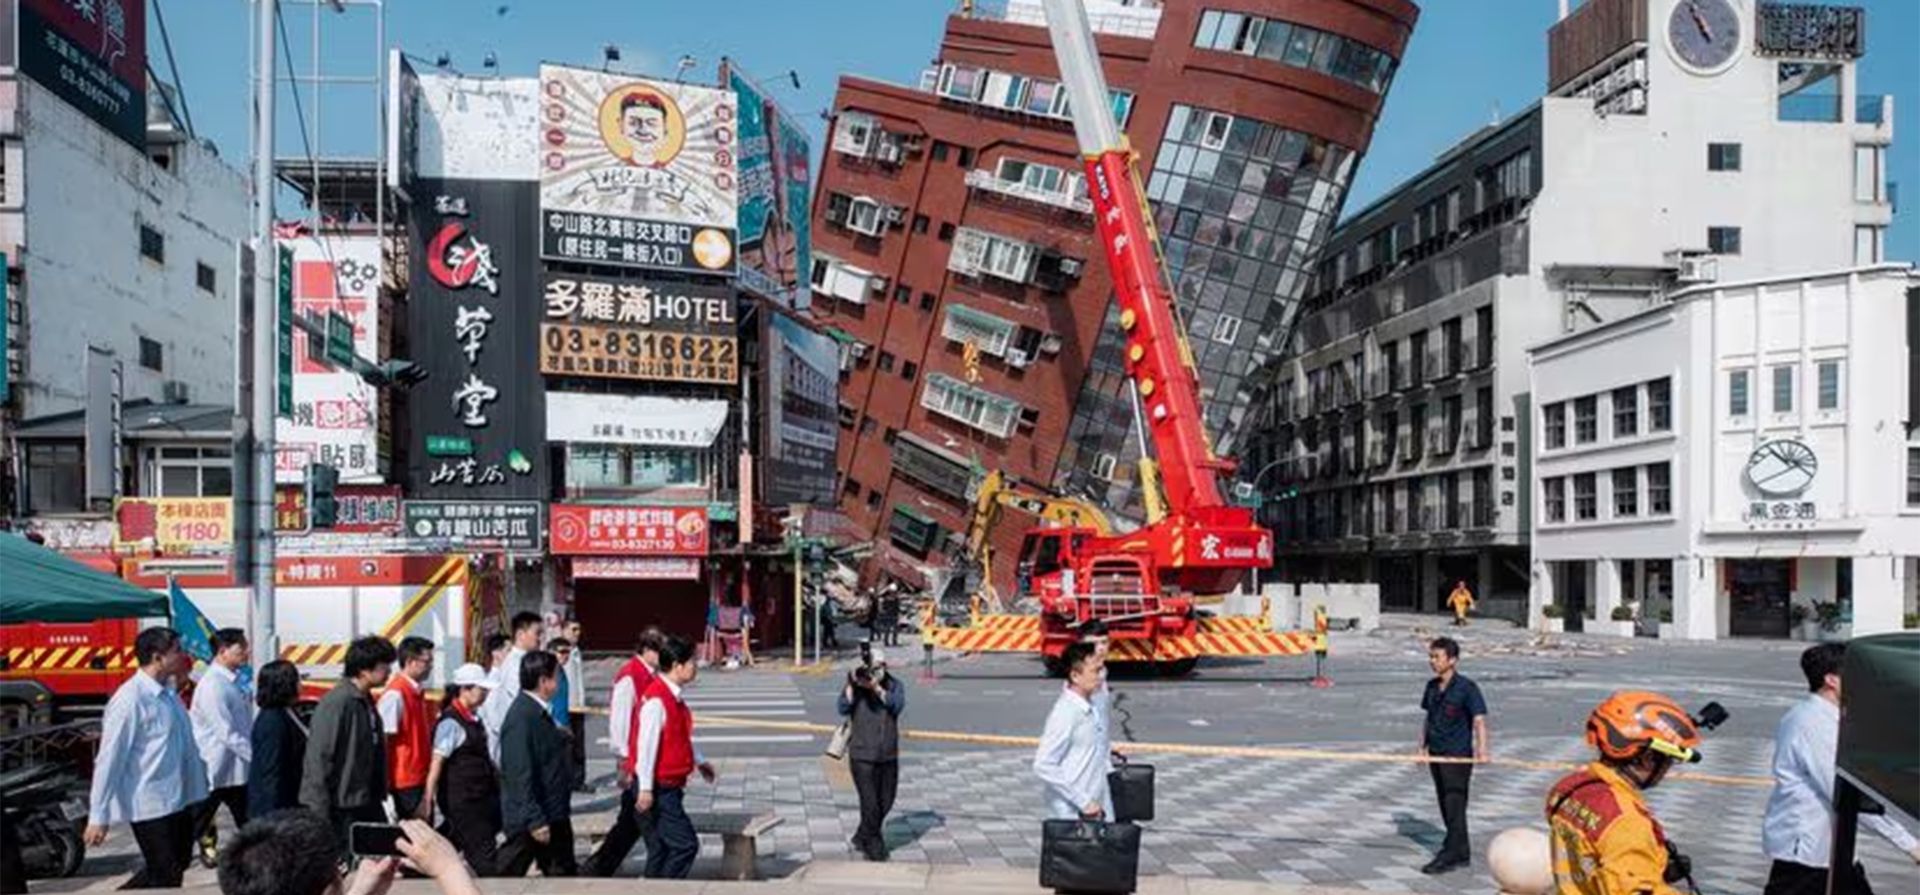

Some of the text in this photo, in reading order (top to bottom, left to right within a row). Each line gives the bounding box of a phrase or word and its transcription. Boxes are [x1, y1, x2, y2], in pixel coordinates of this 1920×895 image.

[544, 279, 735, 324] 多羅滿 HOTEL
[546, 325, 734, 364] 03-8316622
[170, 521, 221, 541] 1180
